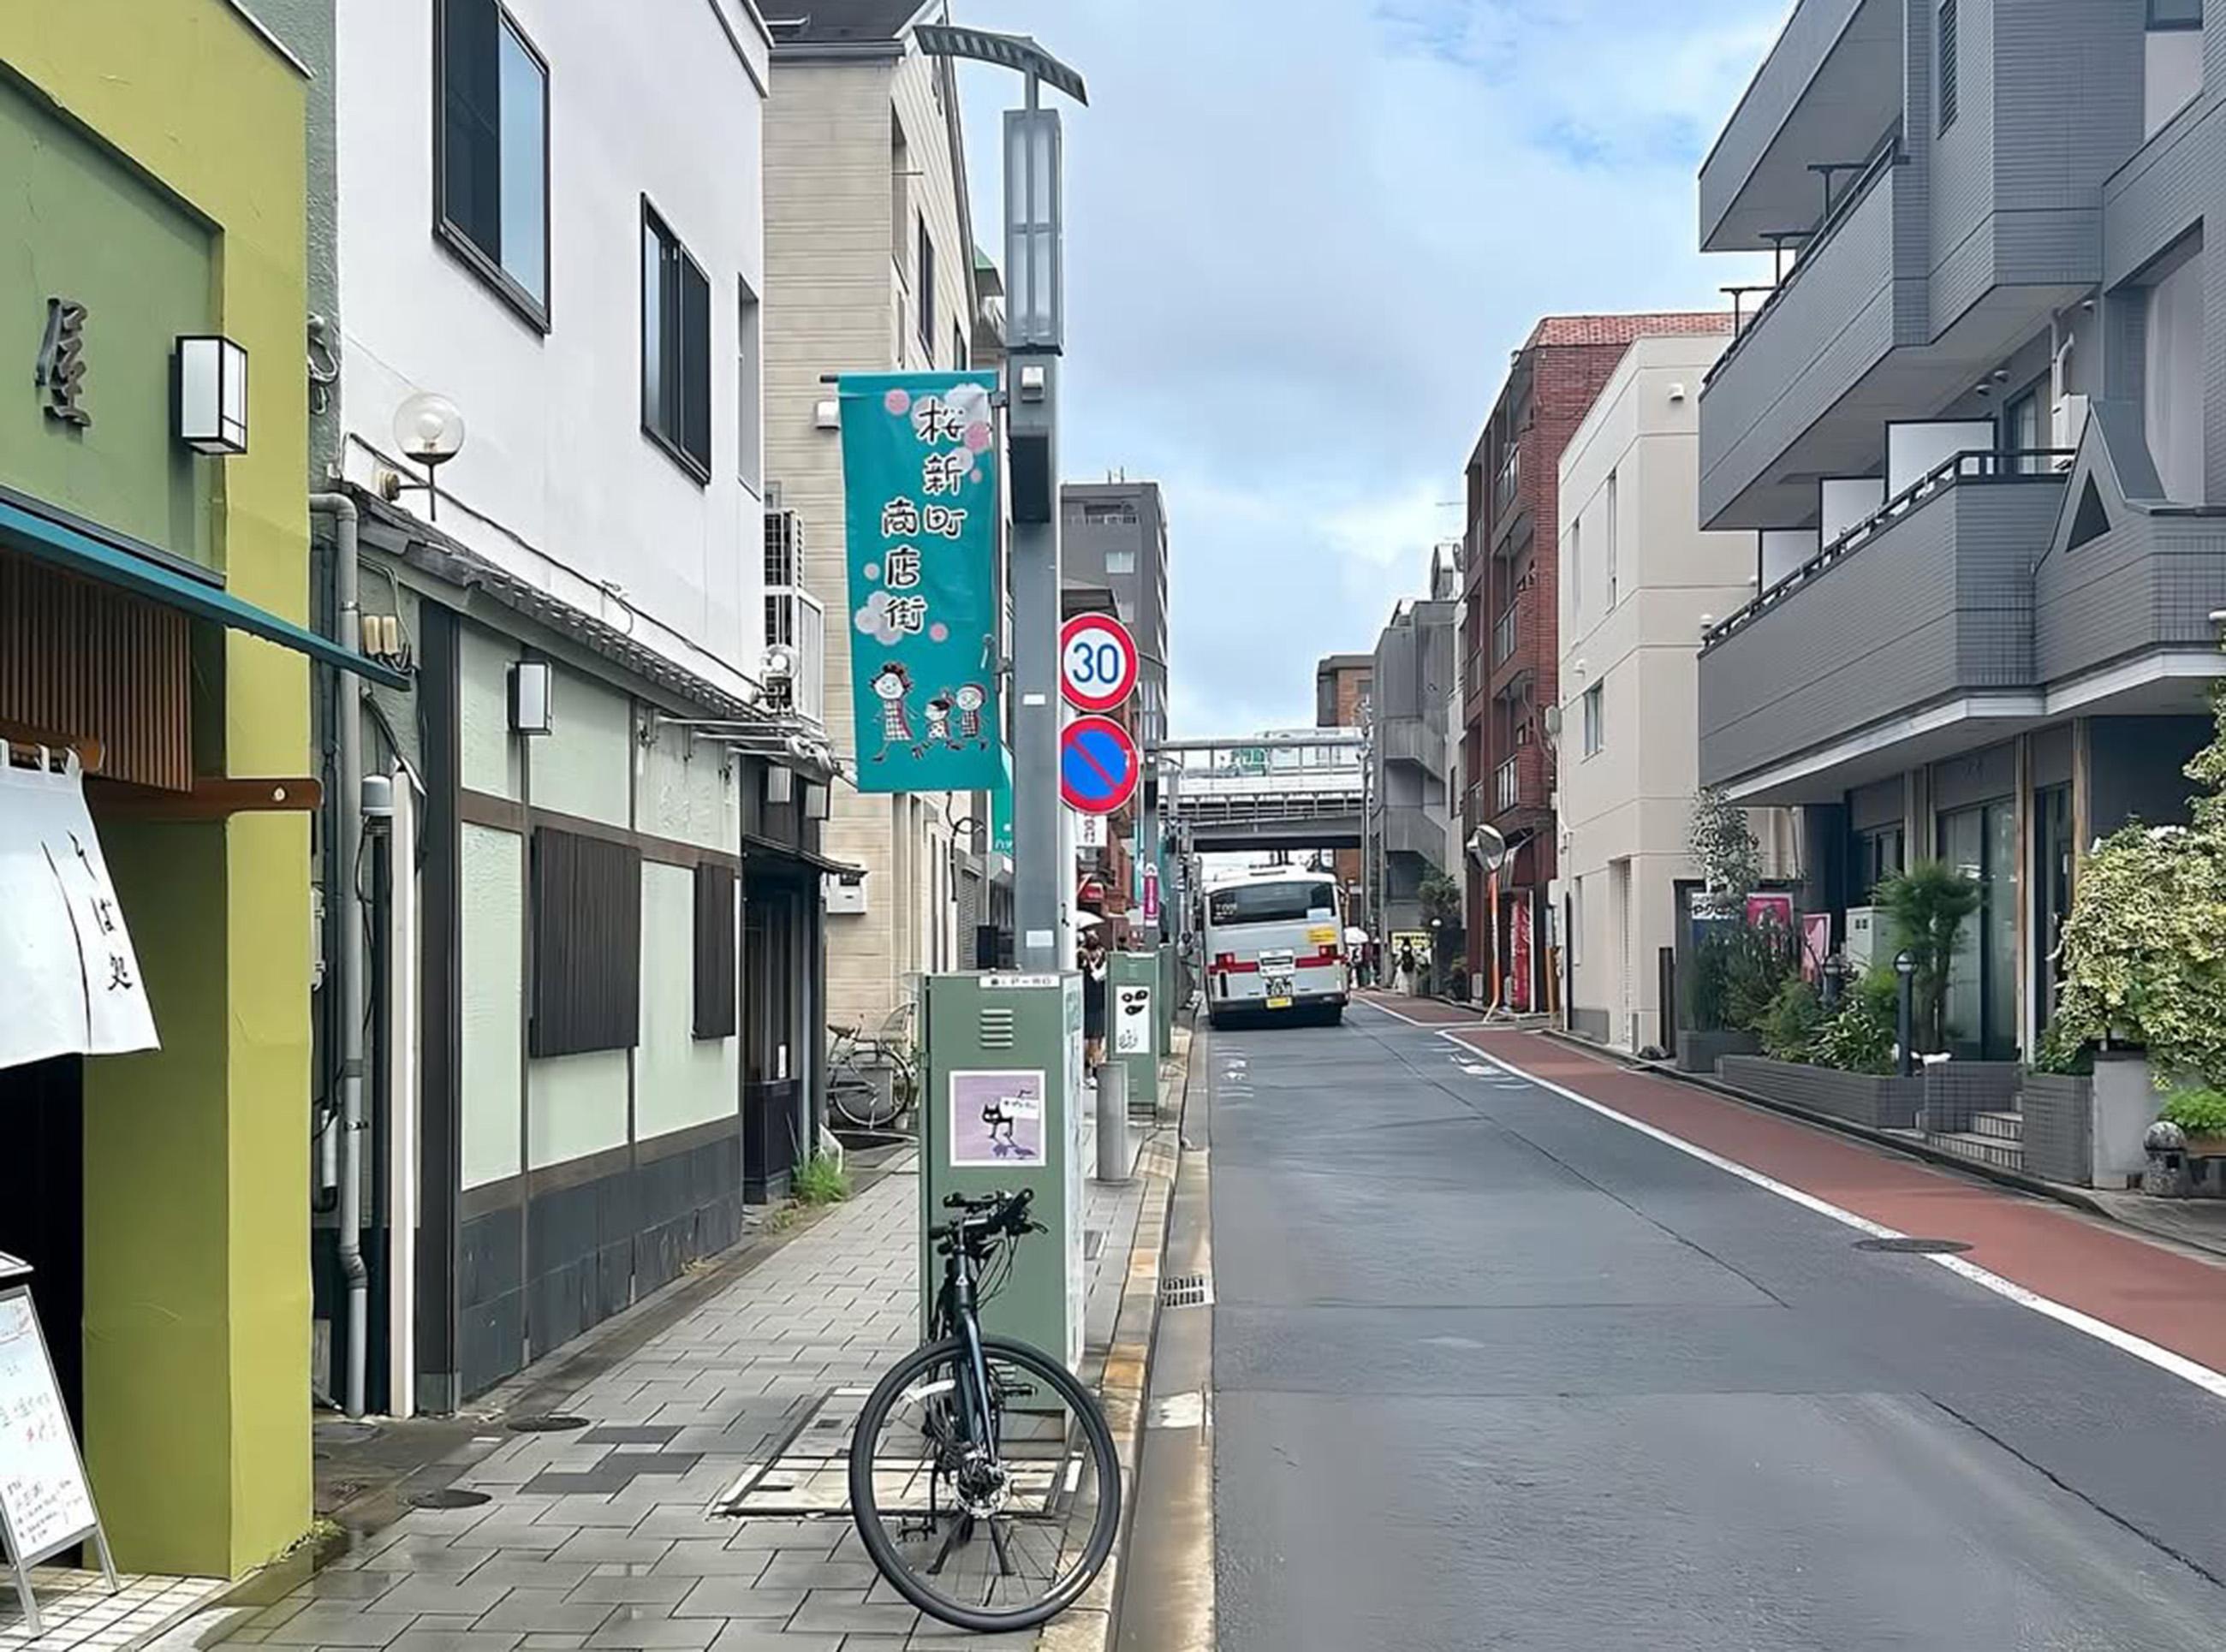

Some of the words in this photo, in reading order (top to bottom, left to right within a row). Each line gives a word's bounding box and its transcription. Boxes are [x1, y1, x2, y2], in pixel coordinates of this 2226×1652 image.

[918, 397, 967, 538] 桜新町
[882, 496, 927, 633] 商店街
[1072, 641, 1120, 684] 30
